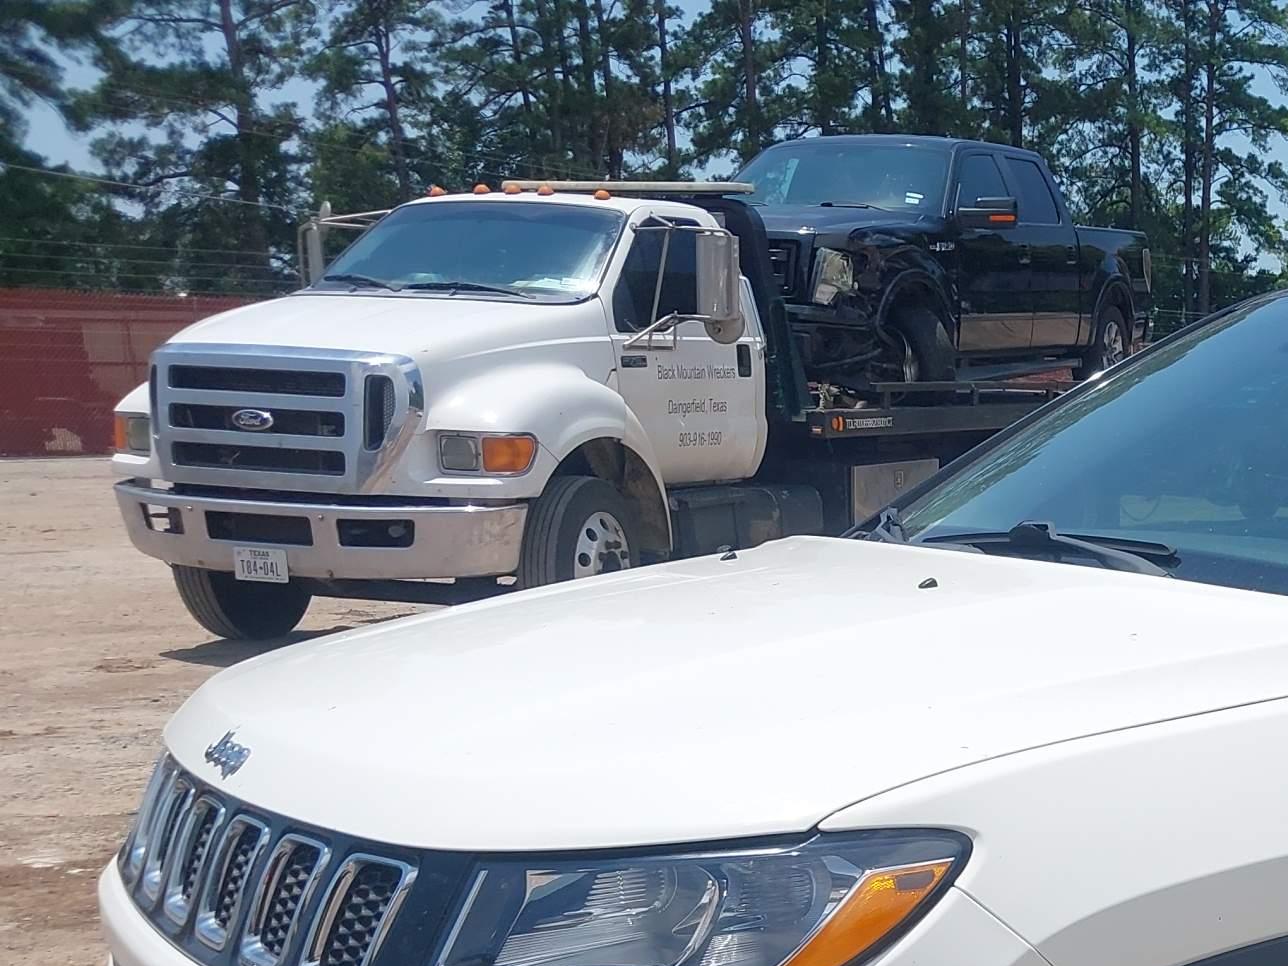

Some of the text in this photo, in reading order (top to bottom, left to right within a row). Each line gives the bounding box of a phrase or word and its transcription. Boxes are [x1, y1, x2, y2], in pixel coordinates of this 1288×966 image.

[657, 364, 736, 380] Black Mountain Wreckers
[709, 398, 728, 414] Texas
